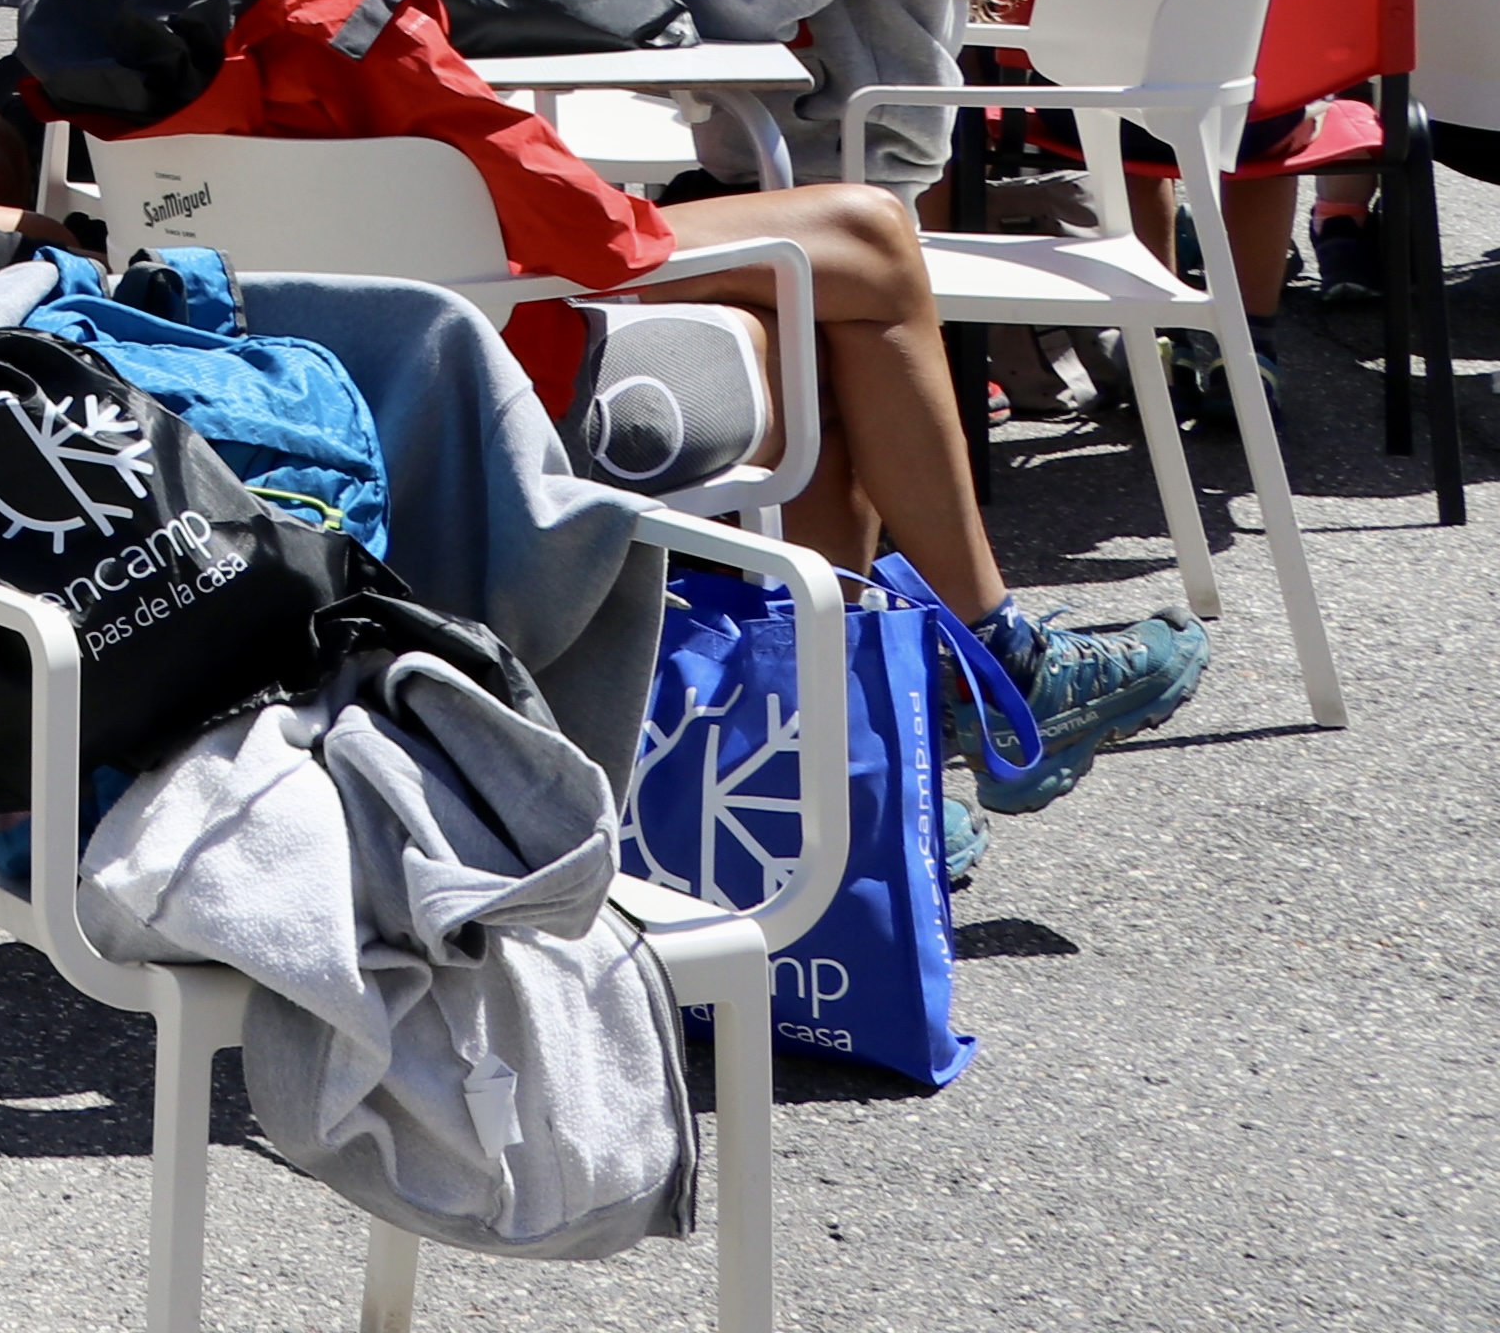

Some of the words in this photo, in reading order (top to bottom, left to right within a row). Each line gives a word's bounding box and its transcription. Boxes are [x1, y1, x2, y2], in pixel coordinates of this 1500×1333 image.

[85, 616, 133, 662] pas
[135, 596, 172, 627] de
[168, 581, 197, 609] la
[196, 552, 249, 594] casa
[1038, 710, 1100, 741] PORTIVA
[777, 1021, 854, 1053] casa
